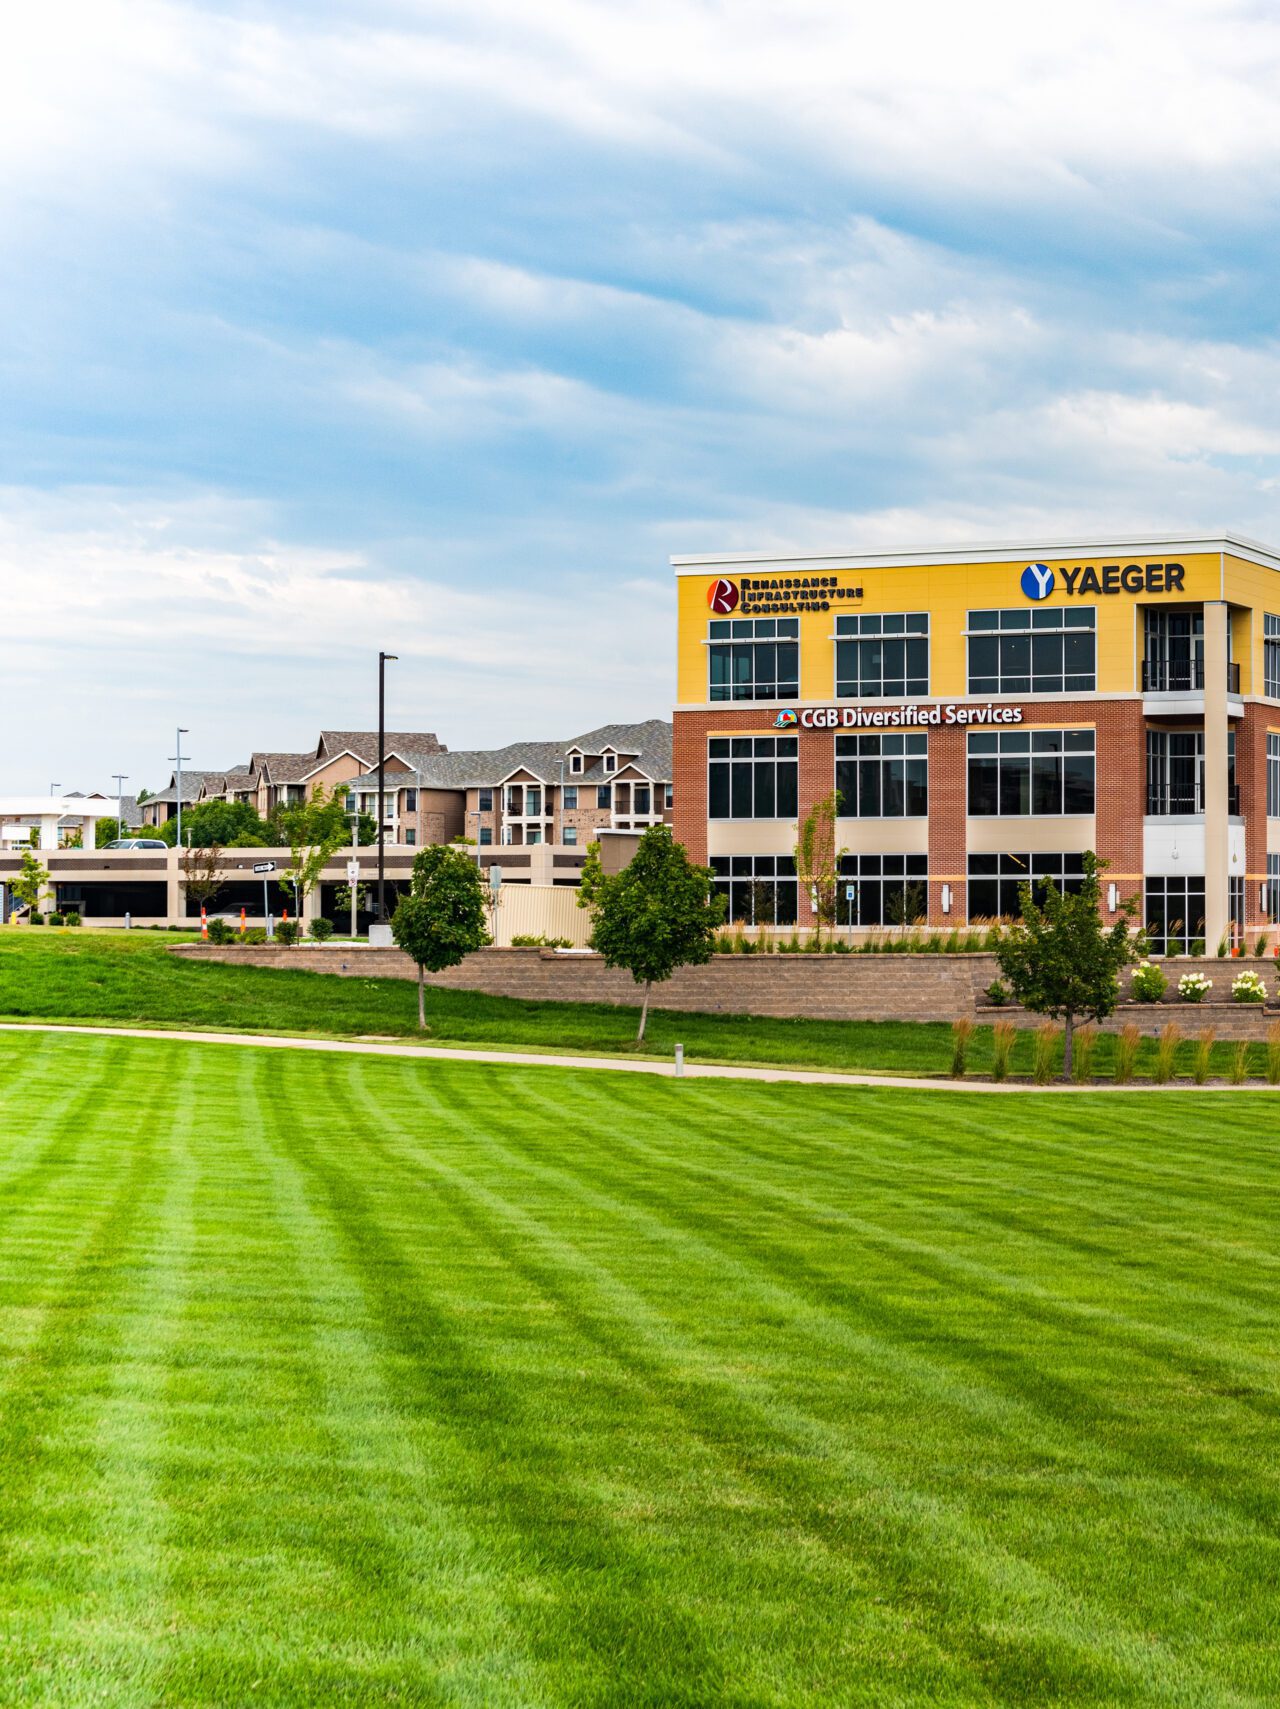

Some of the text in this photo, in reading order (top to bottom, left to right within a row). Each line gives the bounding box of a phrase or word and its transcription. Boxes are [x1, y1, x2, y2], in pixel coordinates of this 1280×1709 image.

[740, 577, 838, 591] RENAISSANCE
[1059, 563, 1185, 595] YAEGER
[740, 588, 864, 602] INFRASTRUCTURE
[740, 601, 830, 614] CONSULTING
[801, 704, 1023, 728] CGB Diversified Services
